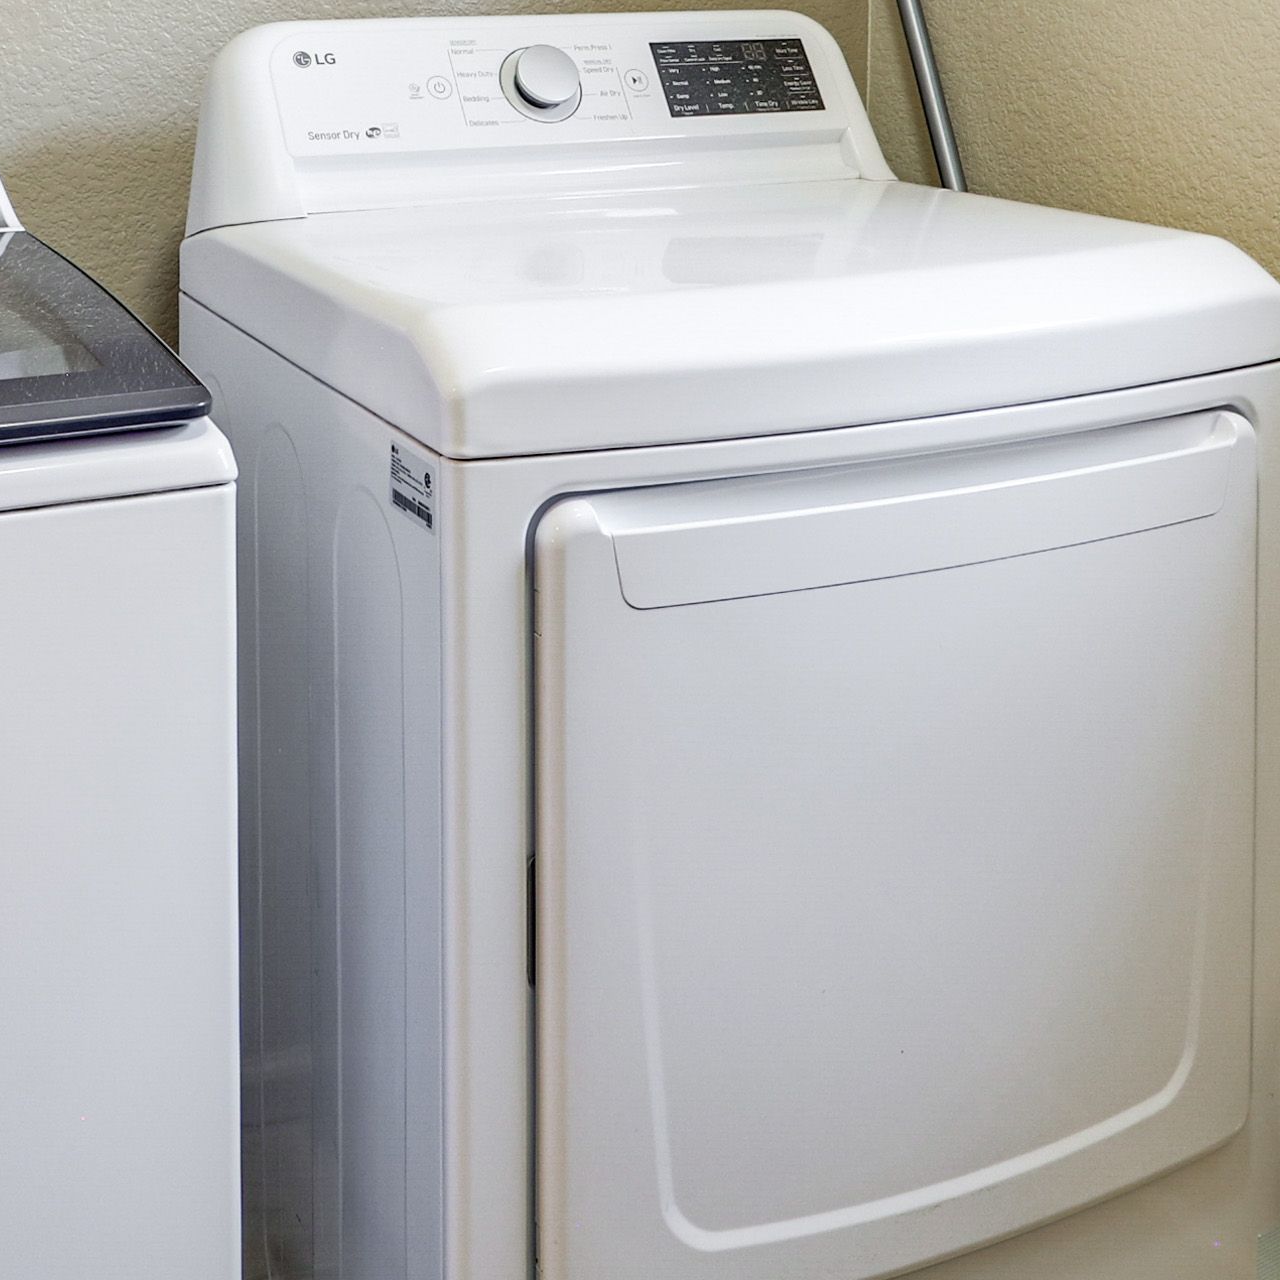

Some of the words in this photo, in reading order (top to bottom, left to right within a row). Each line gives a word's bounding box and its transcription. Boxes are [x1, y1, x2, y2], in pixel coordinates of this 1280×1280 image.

[314, 53, 336, 65] LG
[673, 104, 684, 112] Dry
[684, 103, 700, 111] Level
[308, 130, 341, 141] Sensor
[343, 130, 360, 141] Dry
